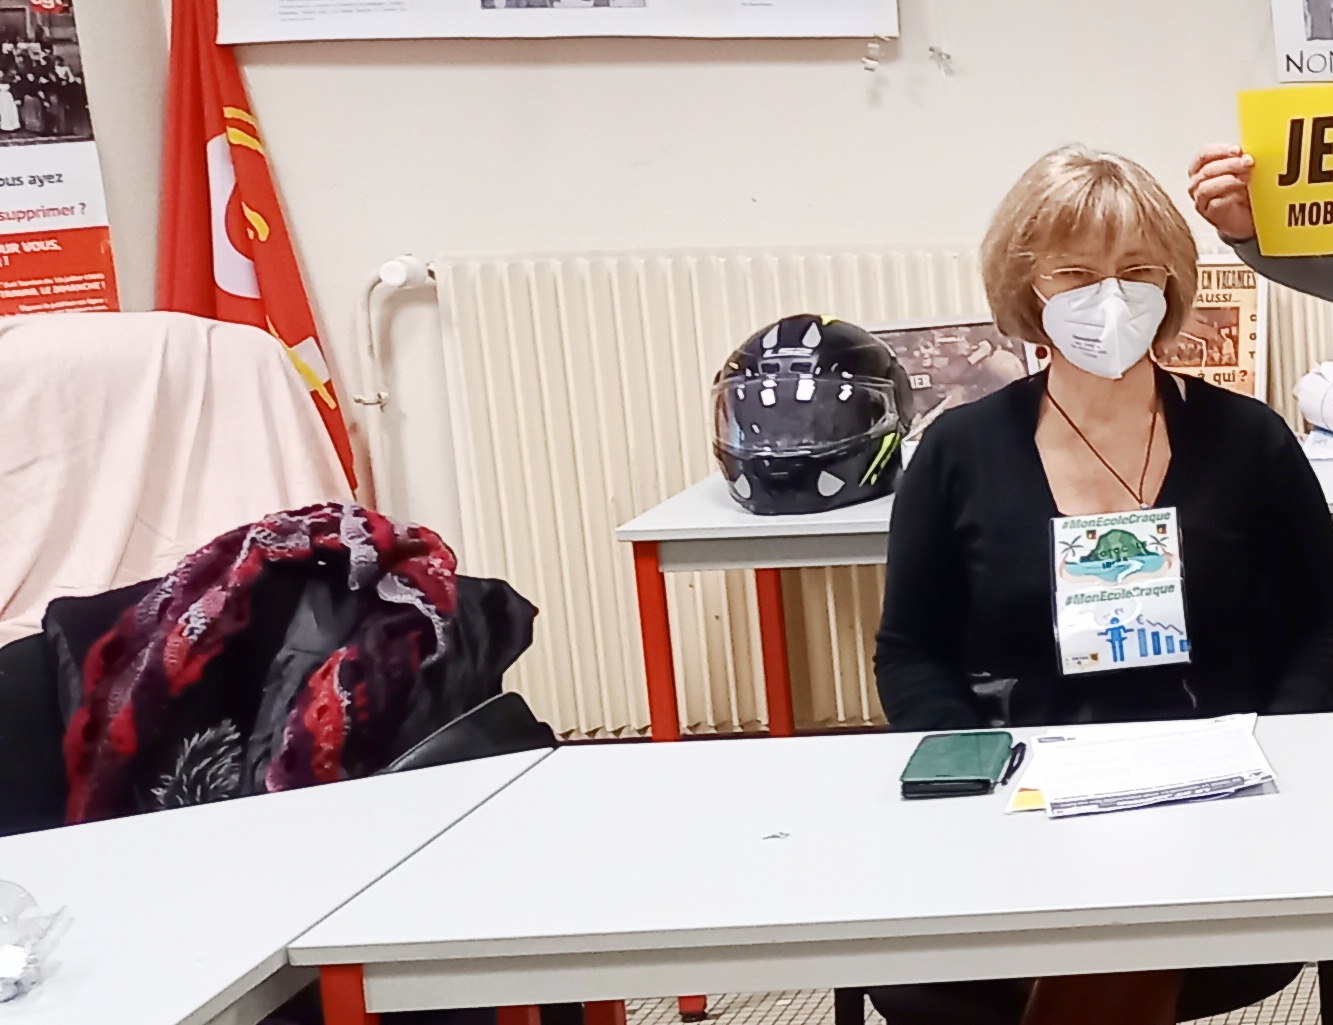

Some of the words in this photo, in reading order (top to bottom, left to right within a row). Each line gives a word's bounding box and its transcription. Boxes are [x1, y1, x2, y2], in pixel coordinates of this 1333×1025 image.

[28, 173, 64, 188] ayez
[1213, 370, 1236, 385] qui
[1238, 369, 1248, 382] ?
[1062, 511, 1171, 530] #MonEcoleCraque
[1065, 583, 1175, 606] #MonEcoleCraque
